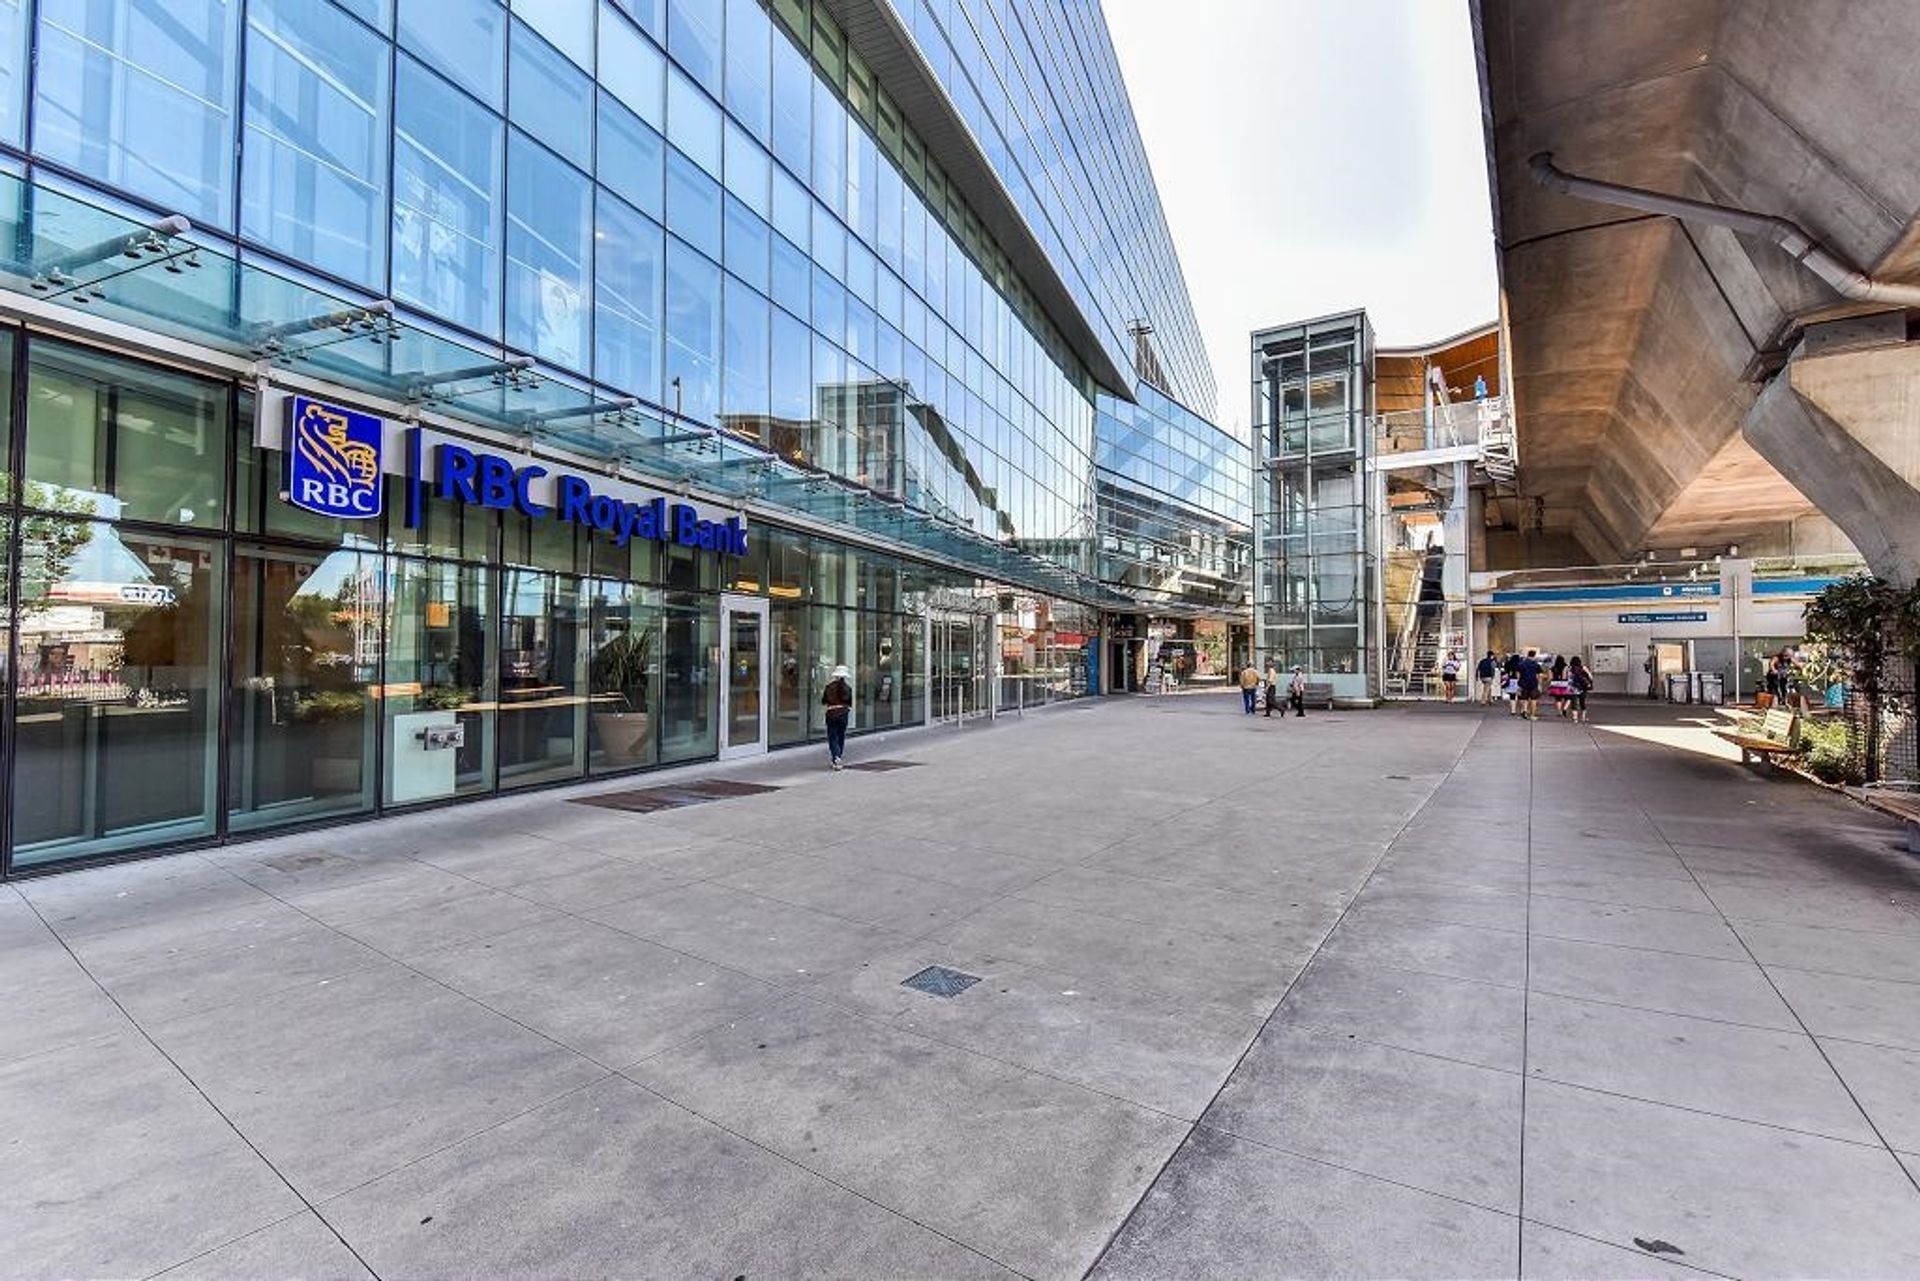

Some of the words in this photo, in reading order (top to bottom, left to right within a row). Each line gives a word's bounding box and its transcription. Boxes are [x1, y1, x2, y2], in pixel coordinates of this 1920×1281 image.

[302, 478, 373, 511] RBC
[436, 443, 548, 518] RBC
[555, 474, 669, 547] Royal
[671, 503, 748, 556] Bank
